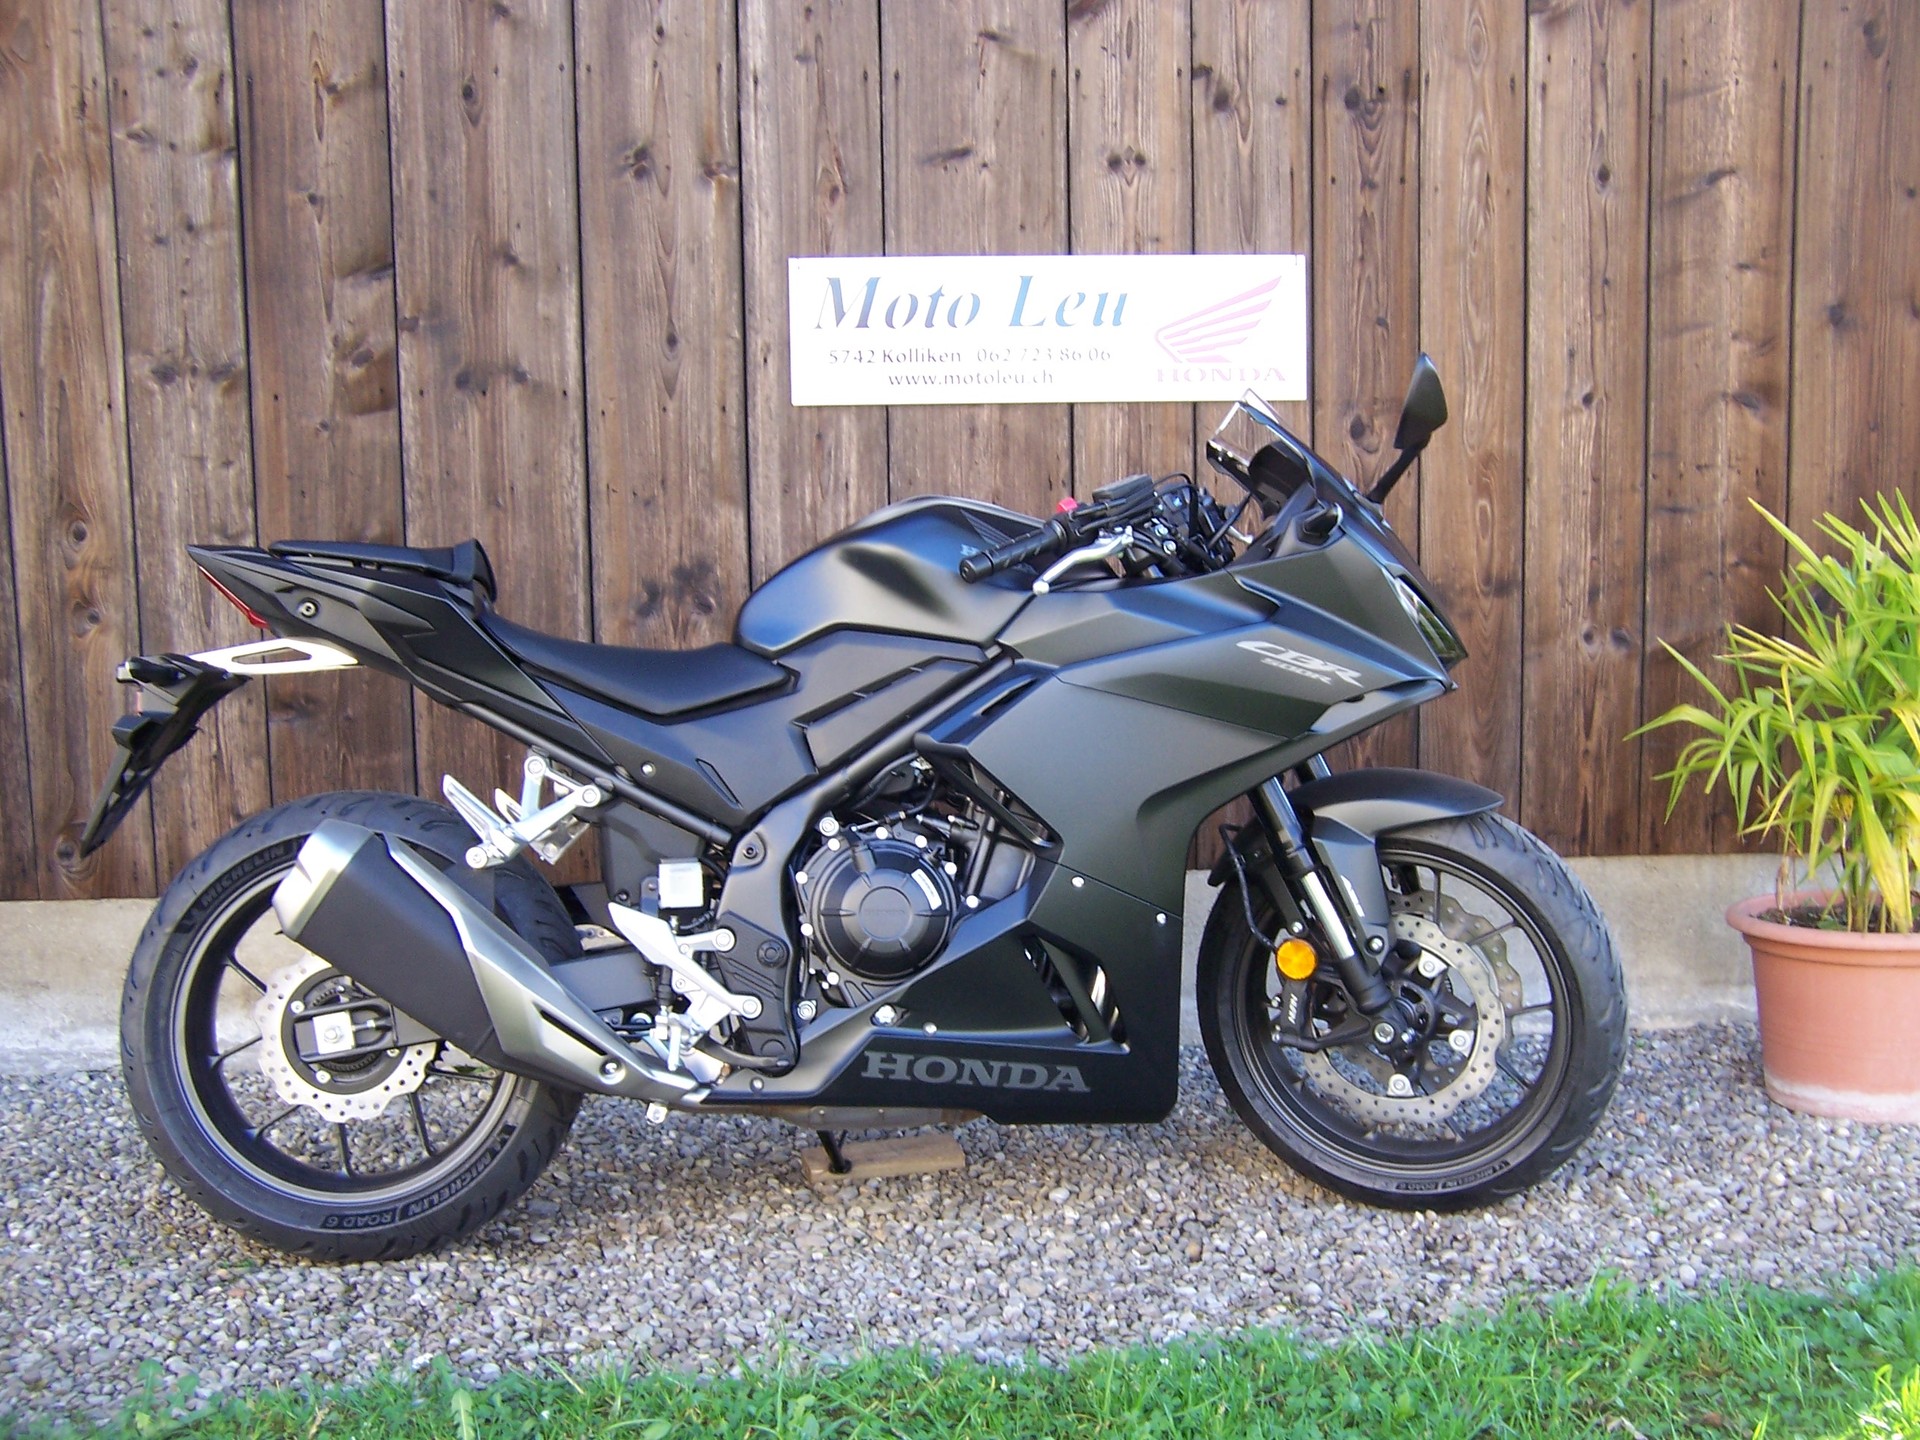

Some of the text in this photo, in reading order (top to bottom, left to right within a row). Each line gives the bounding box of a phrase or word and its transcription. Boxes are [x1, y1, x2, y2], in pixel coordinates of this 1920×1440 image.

[814, 274, 1129, 330] Moto Leu
[828, 349, 875, 364] 5742
[1156, 367, 1287, 382] HONDA
[1236, 640, 1364, 688] CBR
[201, 843, 285, 909] MICHELIN
[861, 1050, 1092, 1093] HONDA
[407, 1150, 492, 1217] MICHELIN
[343, 1210, 394, 1228] ROAD
